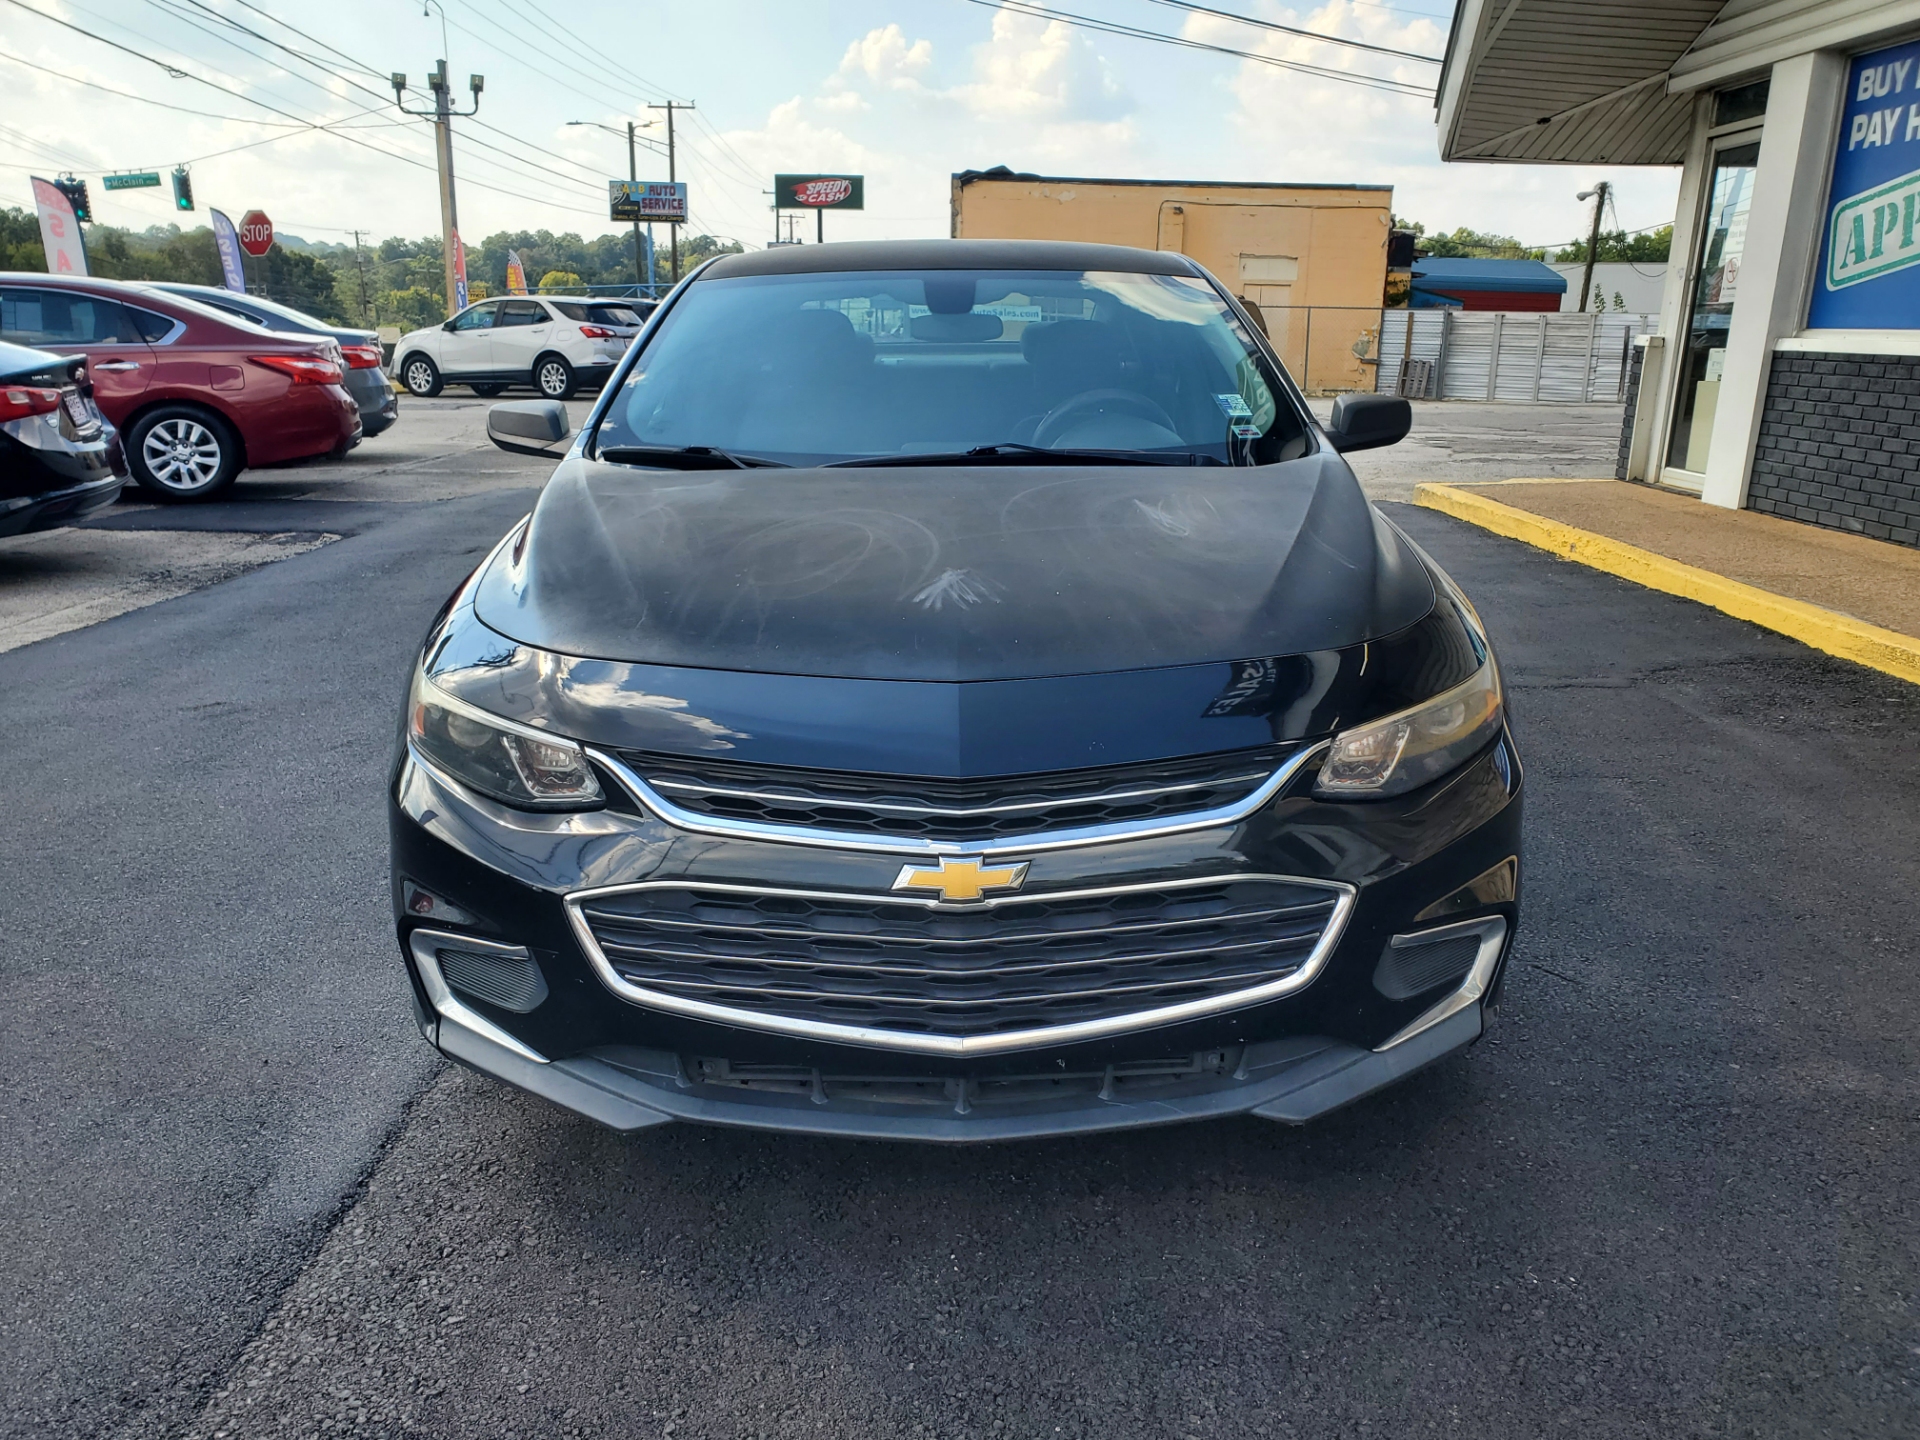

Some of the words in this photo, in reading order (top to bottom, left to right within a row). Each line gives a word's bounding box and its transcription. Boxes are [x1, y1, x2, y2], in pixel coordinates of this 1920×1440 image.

[1856, 58, 1912, 102] BUY
[1848, 106, 1903, 151] PAY
[111, 178, 144, 187] McClain
[806, 180, 850, 195] SPEEDY
[649, 185, 676, 196] AUTO
[641, 197, 684, 210] SERVICE
[243, 224, 271, 242] STOP
